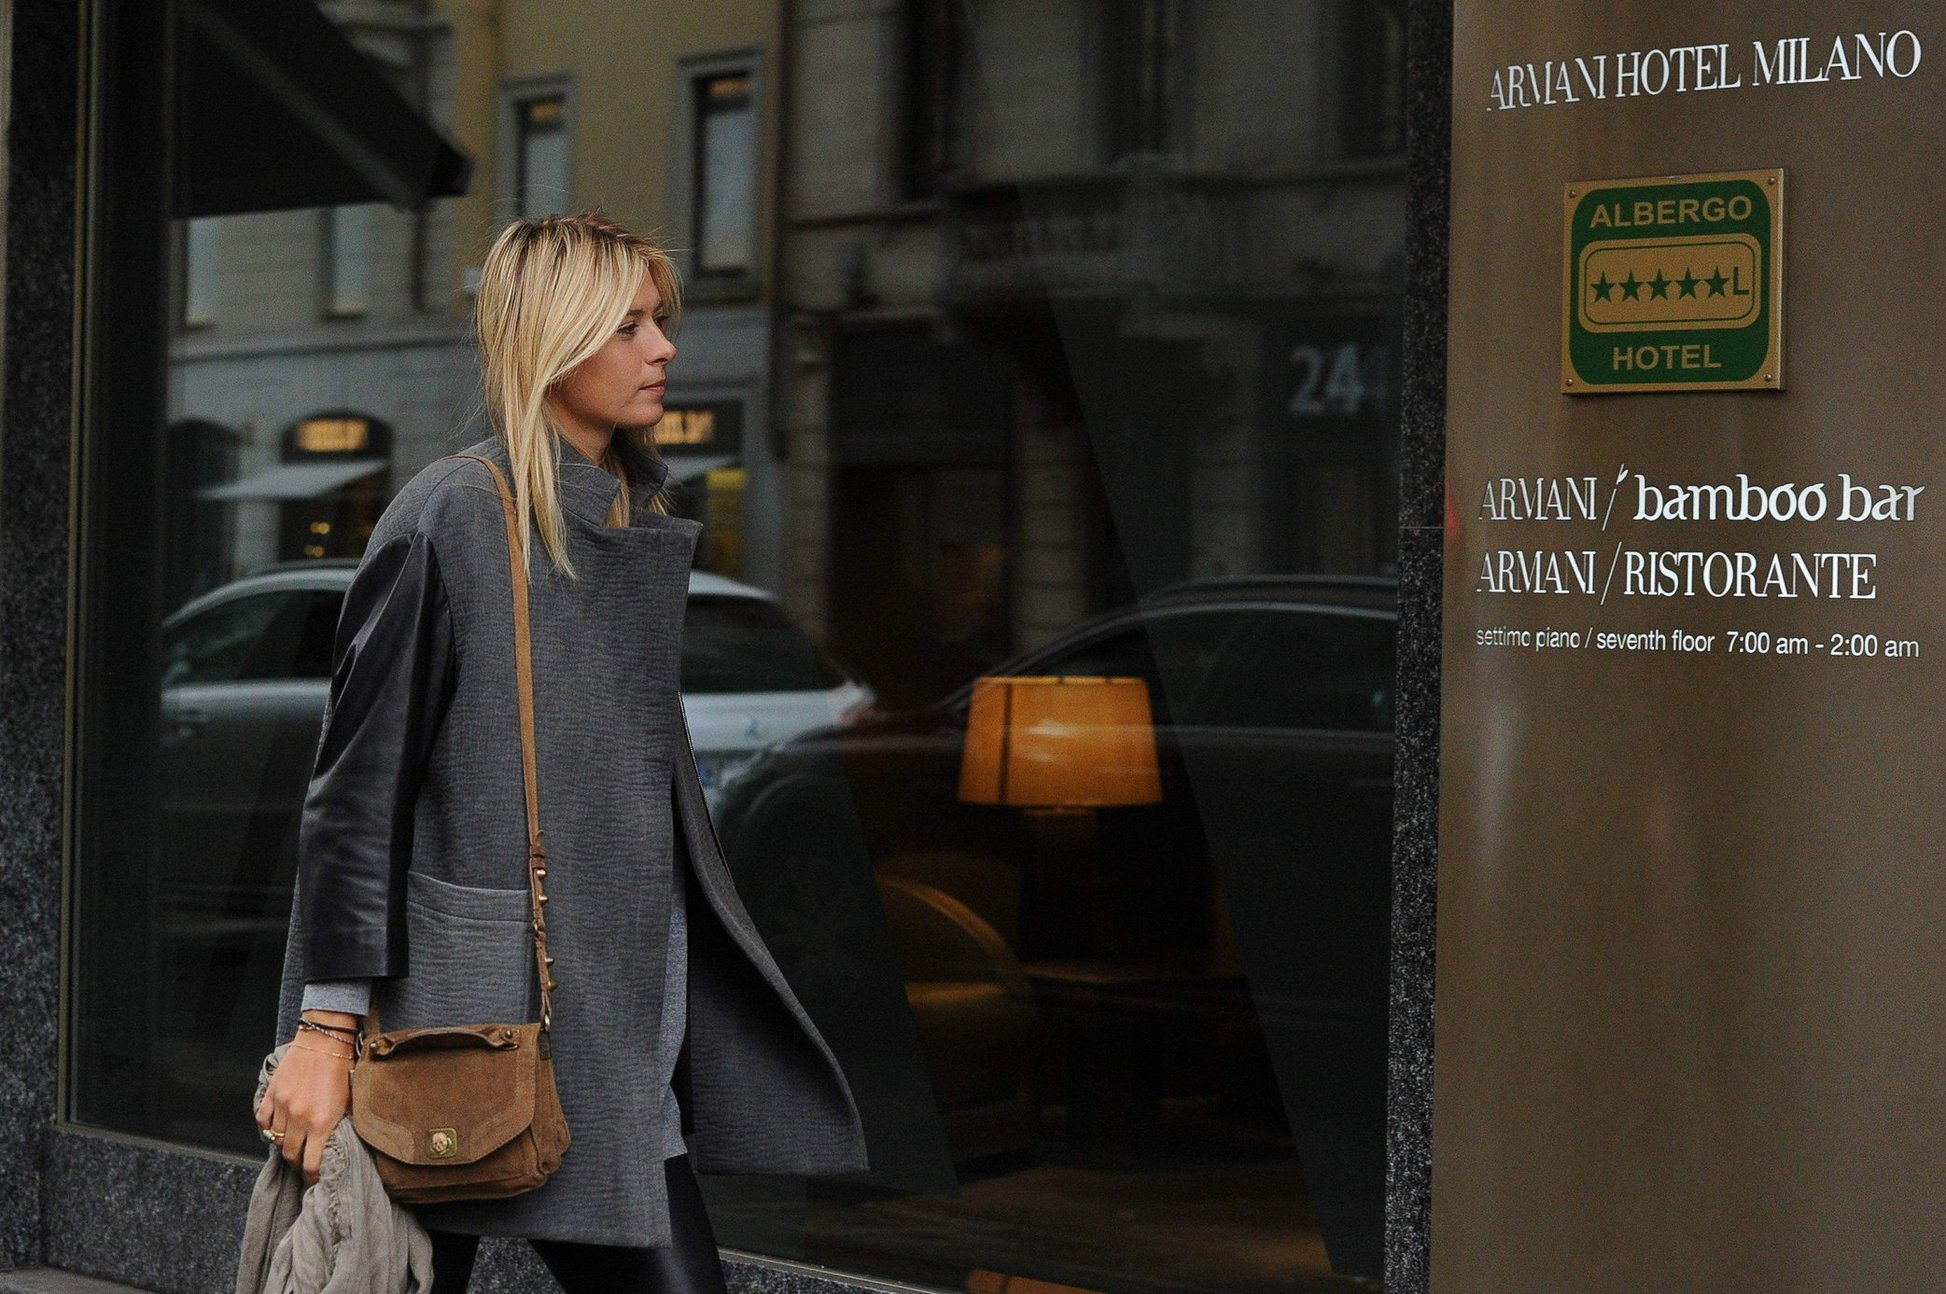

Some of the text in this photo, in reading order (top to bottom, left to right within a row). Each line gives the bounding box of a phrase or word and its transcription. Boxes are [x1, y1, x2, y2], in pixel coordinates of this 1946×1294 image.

[1487, 30, 1921, 111] ARMANI HOTEL MILANO
[1590, 196, 1752, 229] ALBERGO
[1612, 345, 1722, 370] HOTEL
[1479, 477, 1597, 520] ARMANI
[1633, 474, 1827, 521] bamboo
[1836, 474, 1925, 522] bar
[1477, 551, 1596, 594] ARMANI
[1624, 551, 1876, 599] RISTORANTE
[1476, 625, 1531, 646] settimo
[1536, 627, 1580, 651] piano
[1597, 629, 1666, 650] seventh
[1671, 629, 1715, 652] floor
[1727, 631, 1770, 654] 7:00
[1776, 637, 1808, 654] am
[1830, 634, 1878, 656] 2:00
[1885, 640, 1919, 657] am
